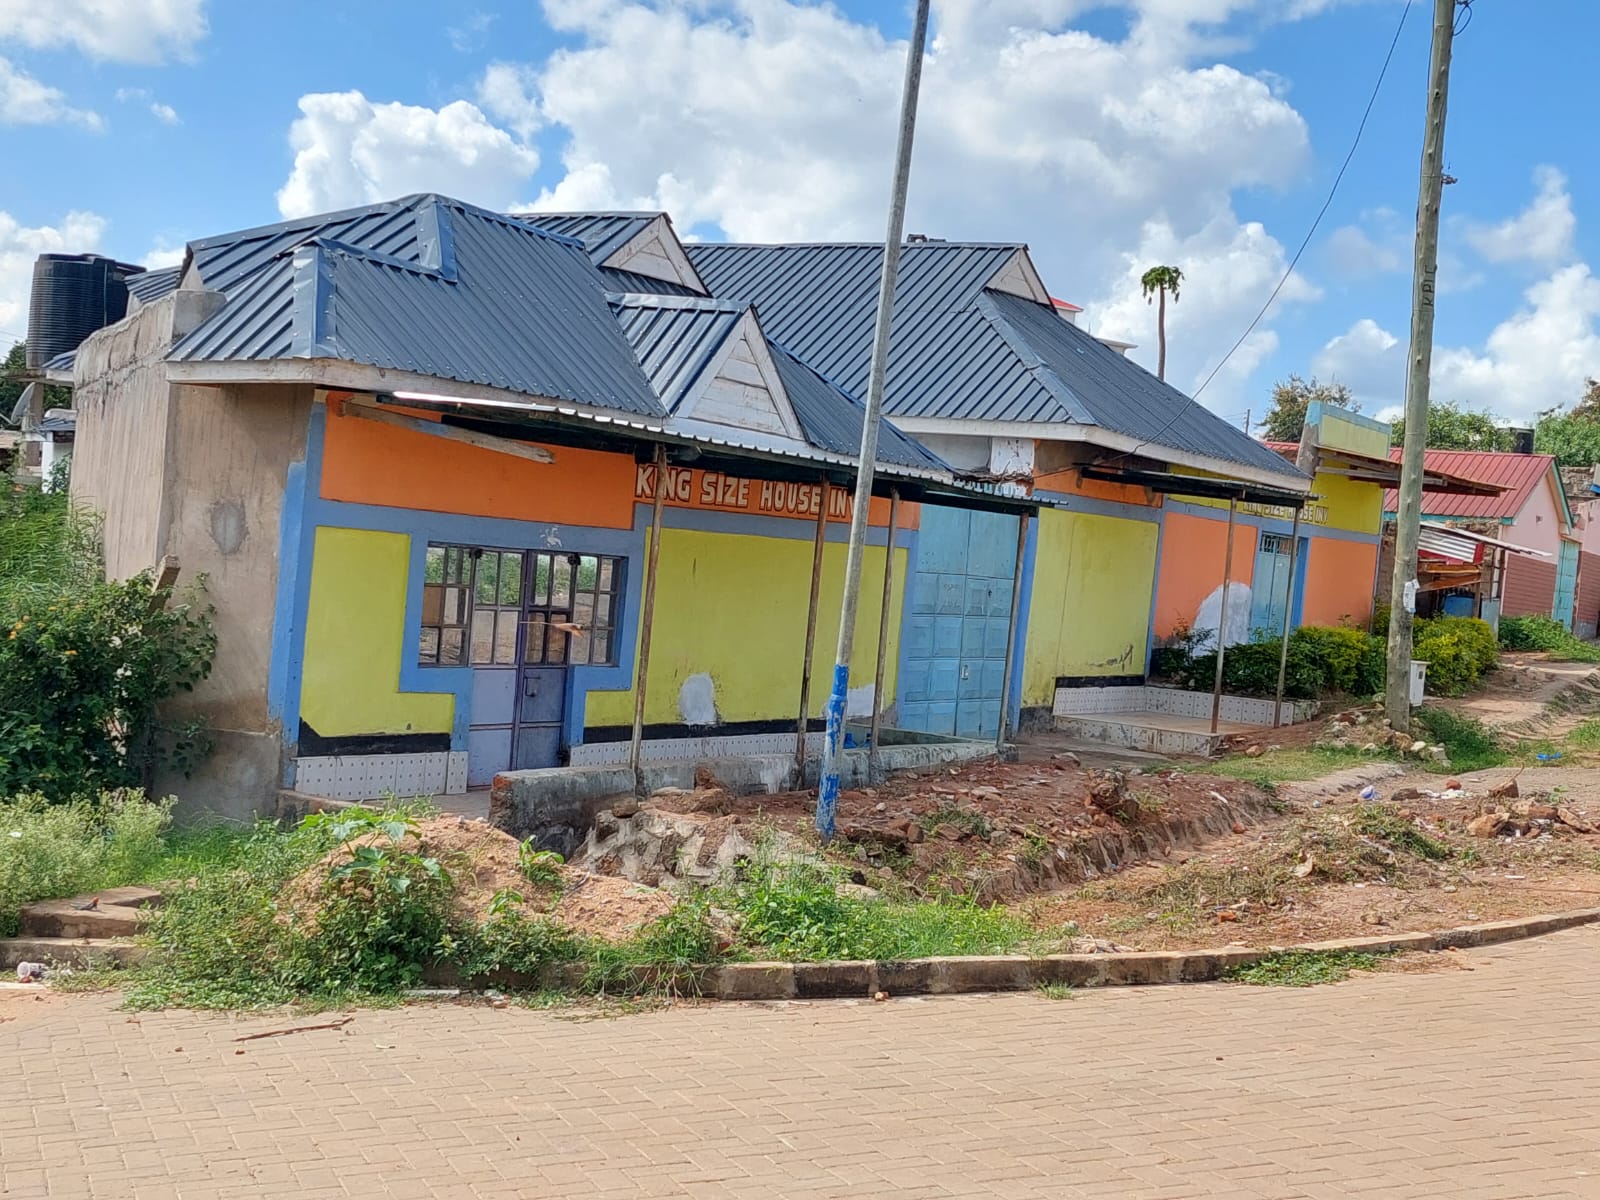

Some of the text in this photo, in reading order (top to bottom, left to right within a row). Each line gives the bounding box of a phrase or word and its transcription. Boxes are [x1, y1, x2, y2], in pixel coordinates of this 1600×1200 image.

[635, 464, 692, 502] KING
[700, 472, 750, 508] SIZE
[759, 480, 821, 515] HOUSE
